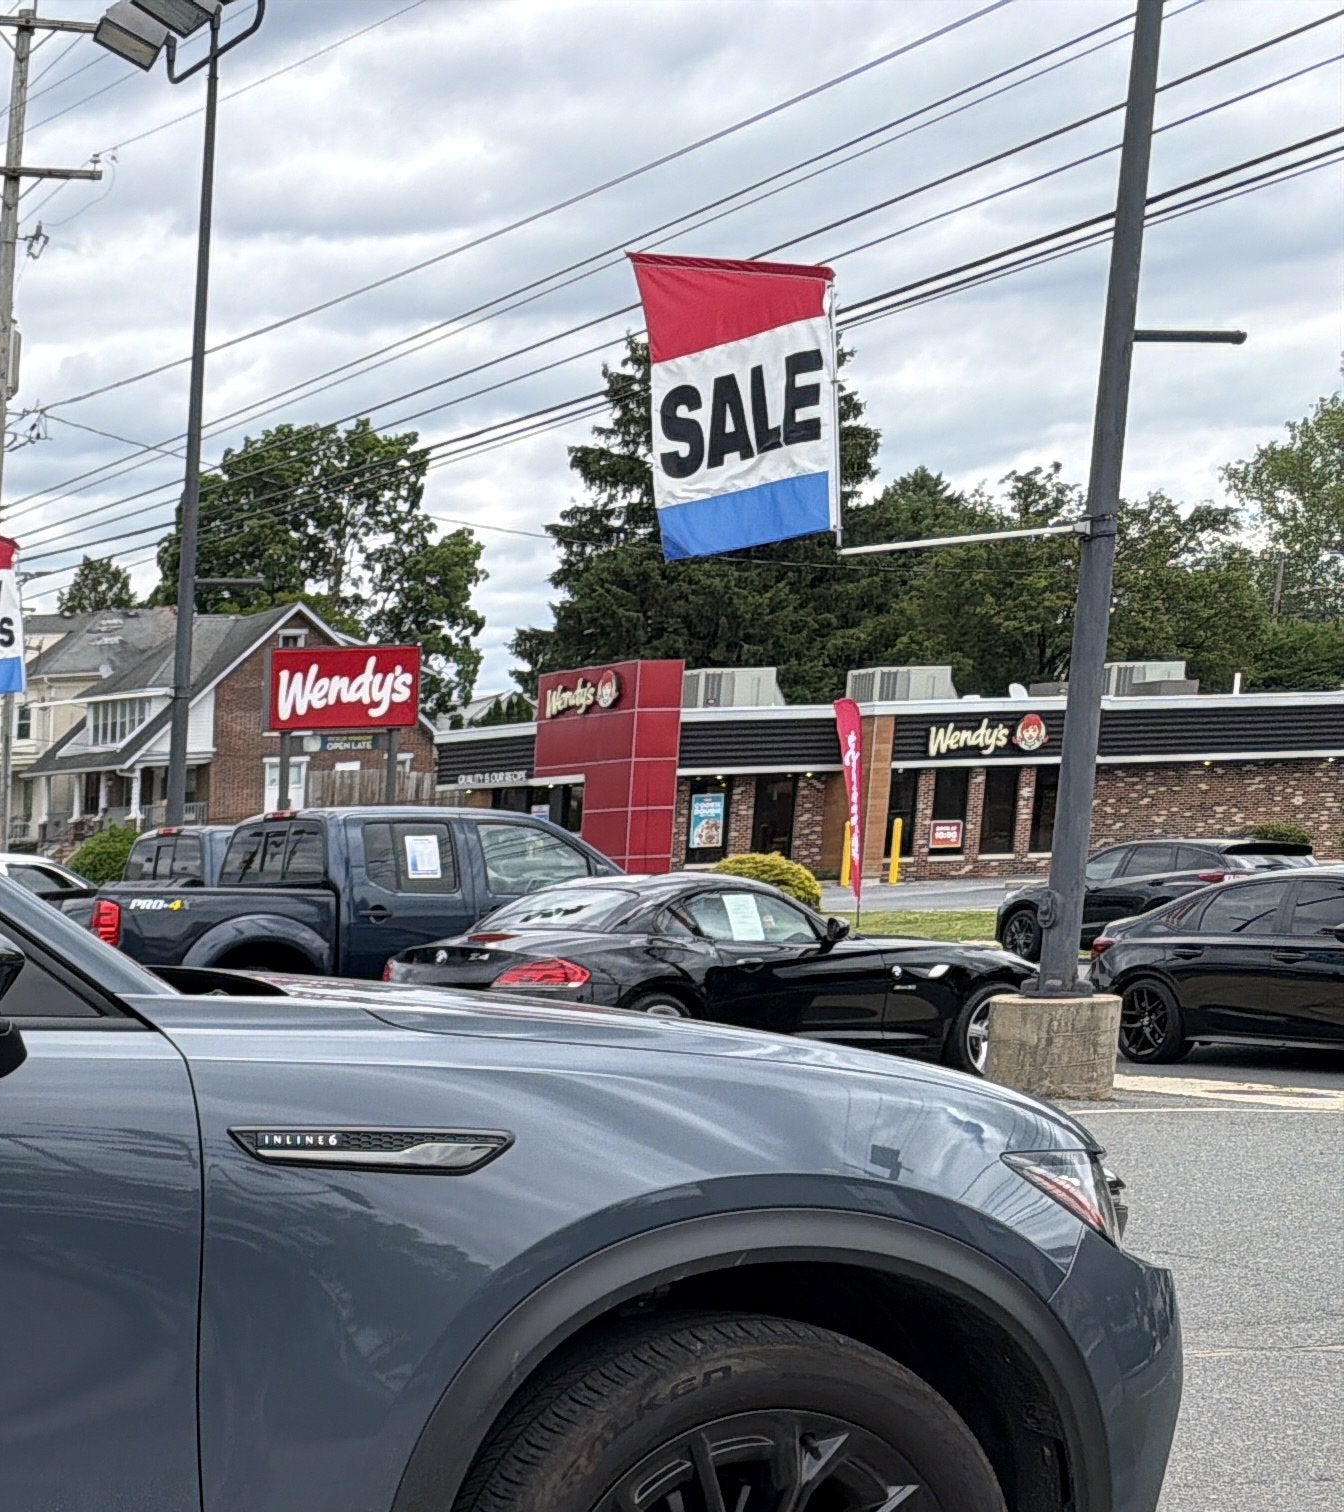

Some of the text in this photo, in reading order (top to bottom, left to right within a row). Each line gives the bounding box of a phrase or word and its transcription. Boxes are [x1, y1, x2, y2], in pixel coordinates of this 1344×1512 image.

[660, 349, 824, 479] SALE
[277, 655, 413, 721] Wendy's
[545, 677, 596, 719] Wendy's
[928, 718, 1009, 757] Wendy's
